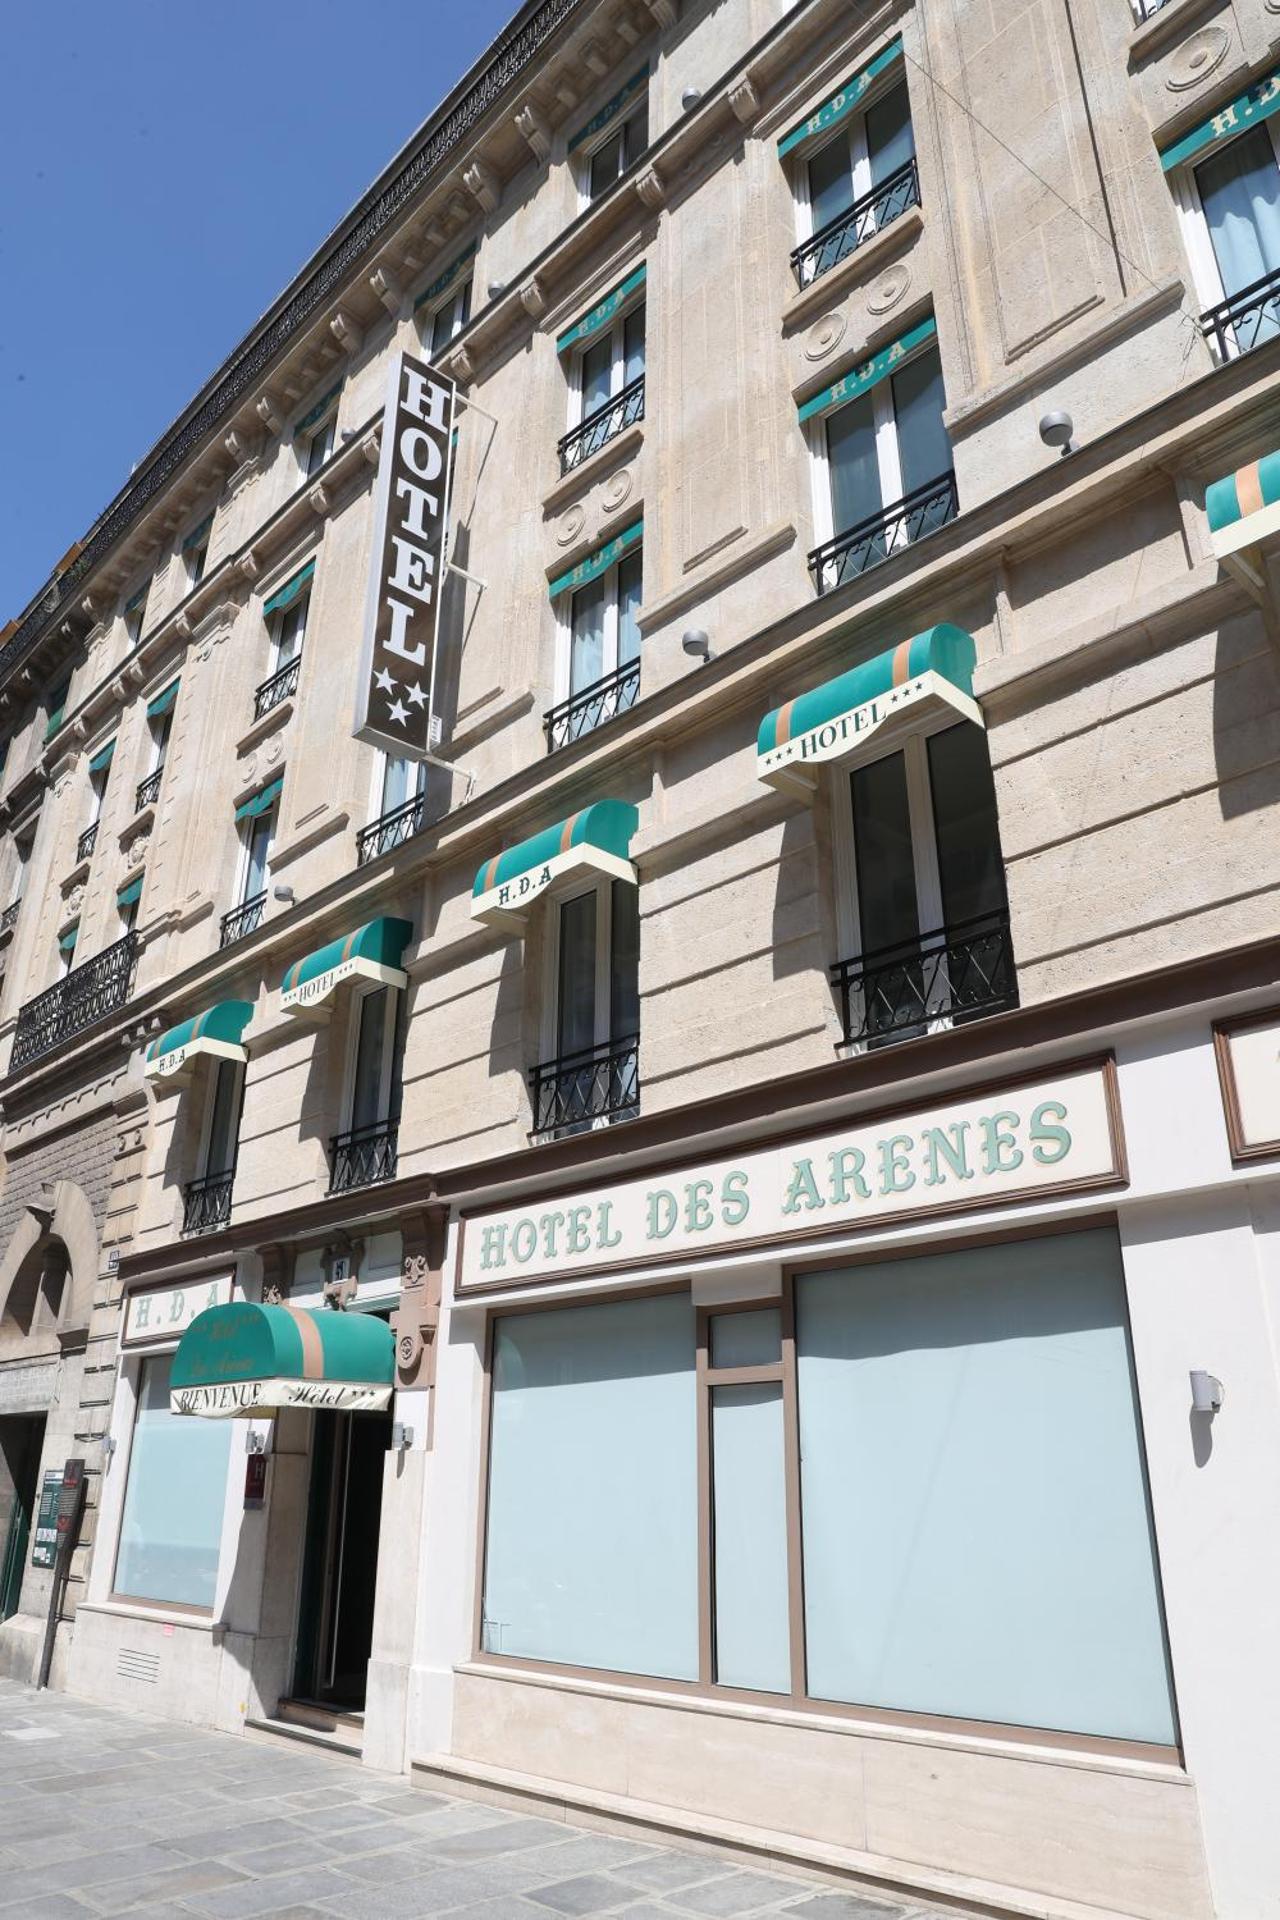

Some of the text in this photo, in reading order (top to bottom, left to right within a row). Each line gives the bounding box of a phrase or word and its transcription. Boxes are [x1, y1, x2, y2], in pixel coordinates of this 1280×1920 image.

[807, 71, 874, 135] H.D.A
[383, 365, 452, 667] HOTEL
[800, 702, 888, 759] HOTEL
[498, 865, 552, 906] H.D.A
[298, 972, 336, 1002] HOTEL
[480, 1100, 1073, 1270] HOTEL DES ARENES
[180, 1383, 262, 1411] BIENVENUE
[288, 1386, 347, 1405] Hôtel
